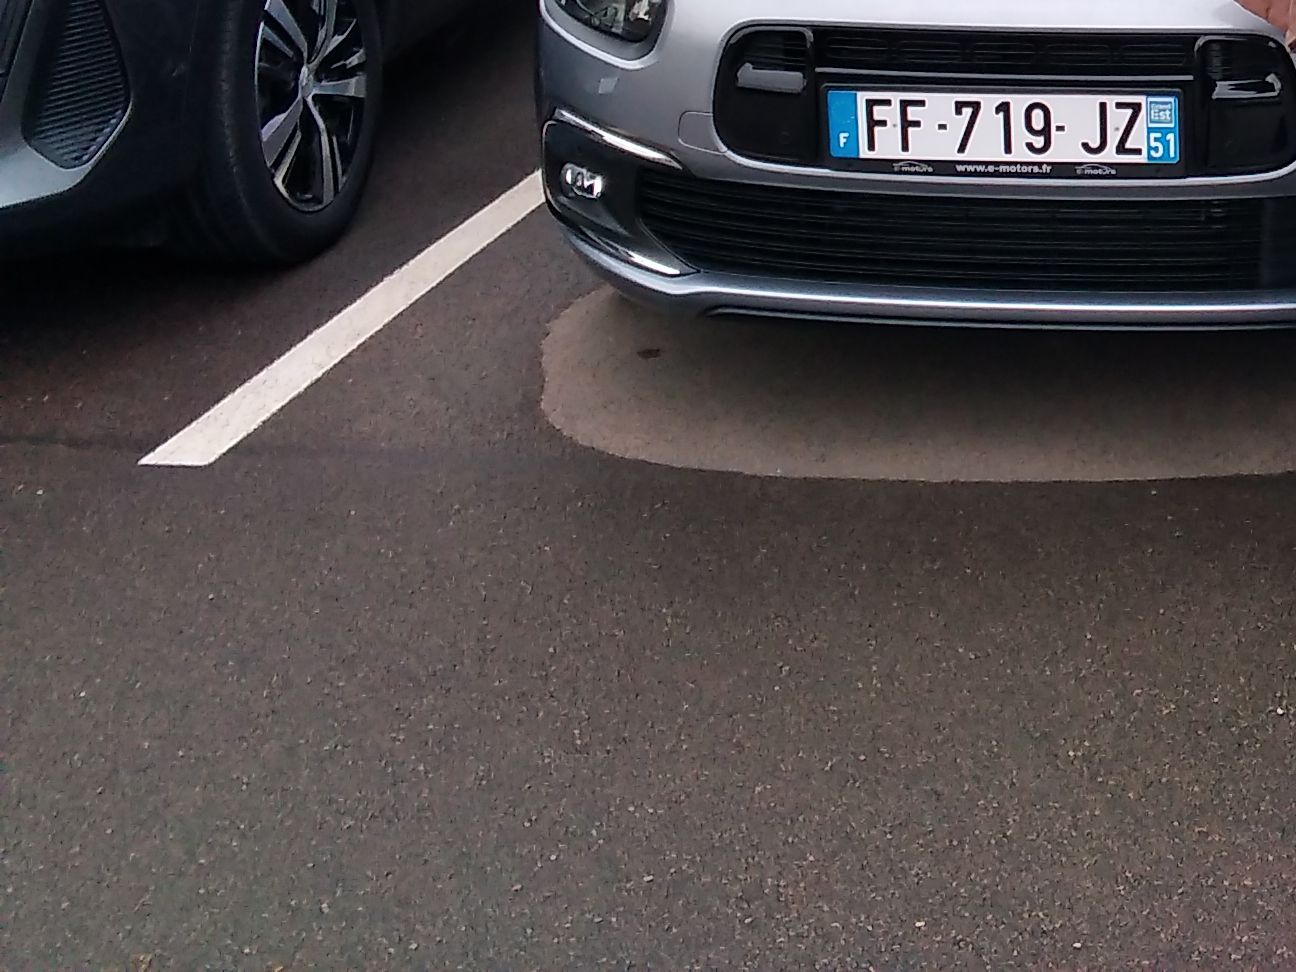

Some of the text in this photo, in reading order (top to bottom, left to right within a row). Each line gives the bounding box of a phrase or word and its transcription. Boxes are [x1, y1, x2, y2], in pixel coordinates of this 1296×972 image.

[1150, 109, 1172, 121] Est
[838, 132, 850, 148] F
[1149, 132, 1175, 158] 51
[955, 164, 1052, 174] www.e-motors.fr
